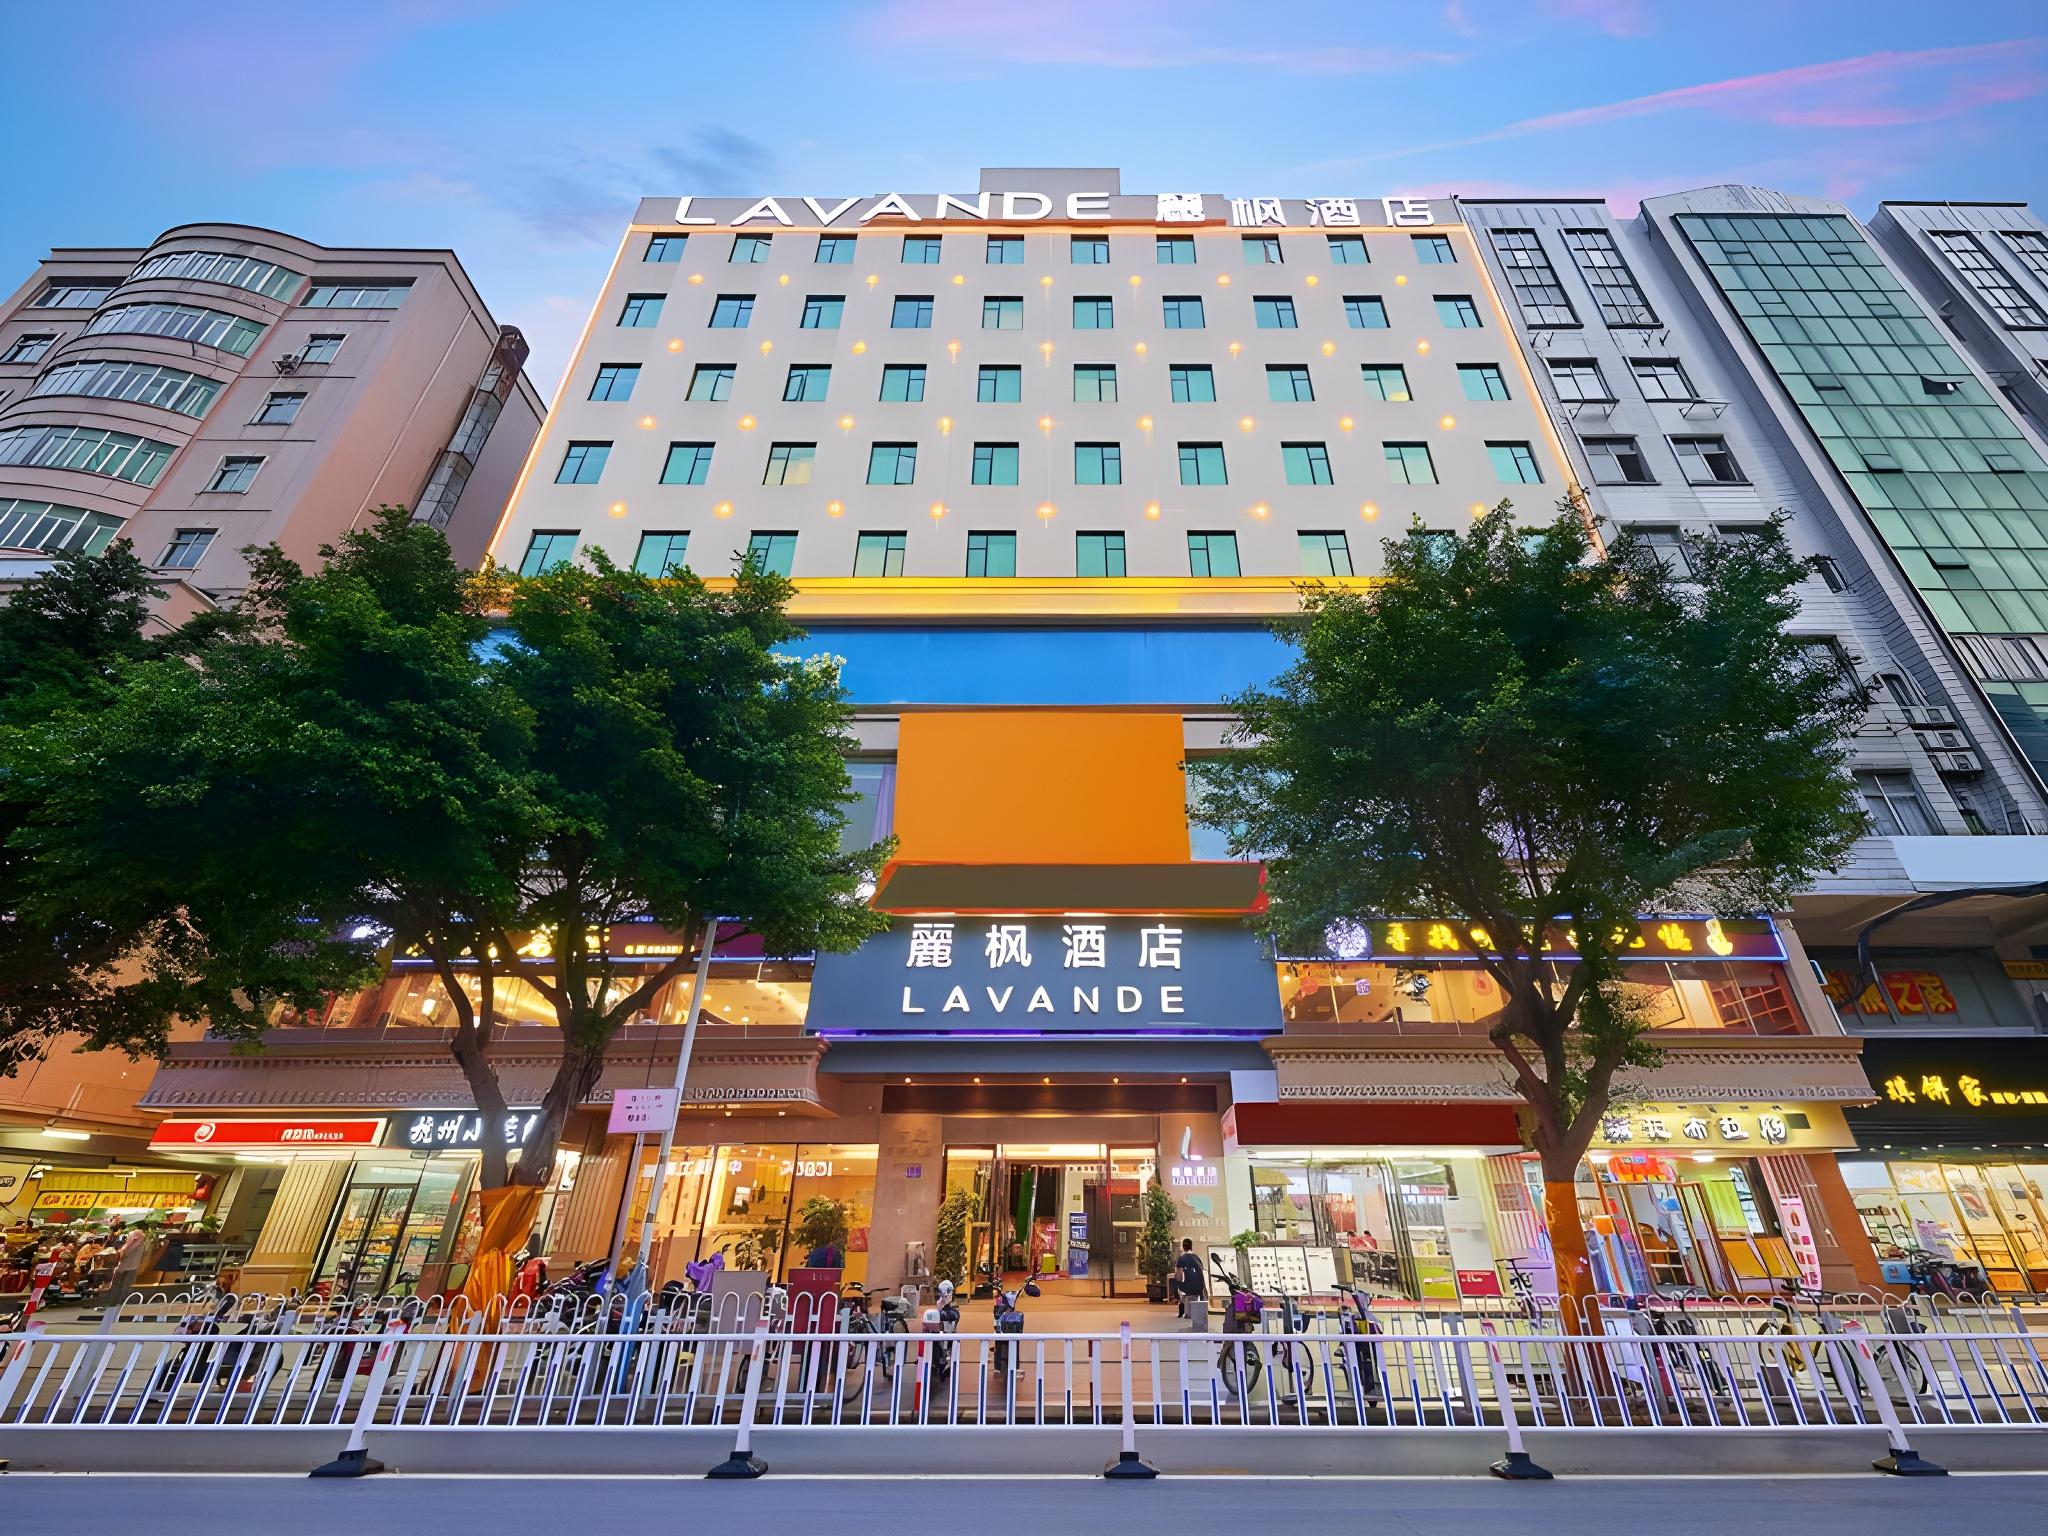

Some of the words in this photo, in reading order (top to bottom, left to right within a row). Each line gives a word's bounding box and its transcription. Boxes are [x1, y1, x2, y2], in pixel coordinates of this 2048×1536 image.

[675, 192, 1111, 227] LAVANDE
[906, 923, 1183, 969] 麗枫酒店
[902, 985, 1186, 1014] LAVANDE
